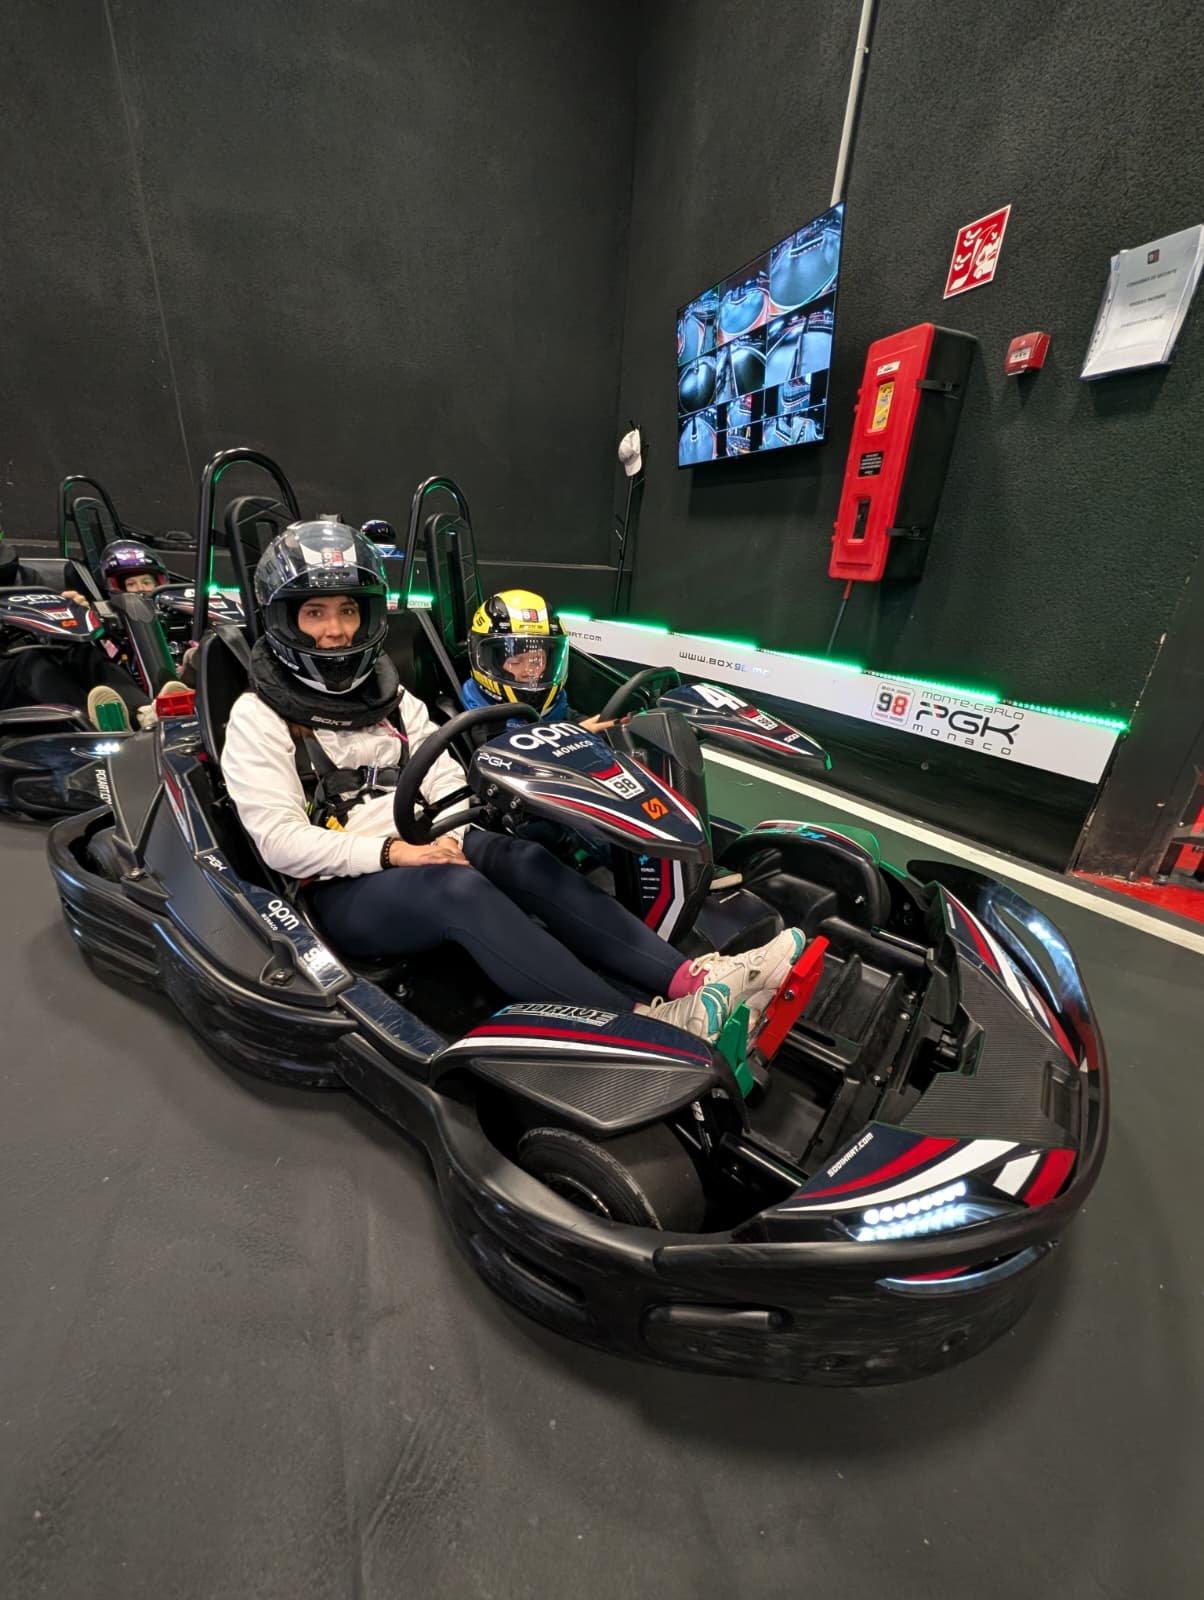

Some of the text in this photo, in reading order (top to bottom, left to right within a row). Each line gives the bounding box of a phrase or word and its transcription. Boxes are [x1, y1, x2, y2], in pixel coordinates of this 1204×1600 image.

[877, 692, 909, 716] 98
[916, 701, 1021, 745] PGK
[509, 722, 588, 750] apm
[551, 740, 594, 758] MONACO
[477, 752, 513, 771] PGK
[613, 778, 637, 794] 98
[268, 899, 300, 931] apm
